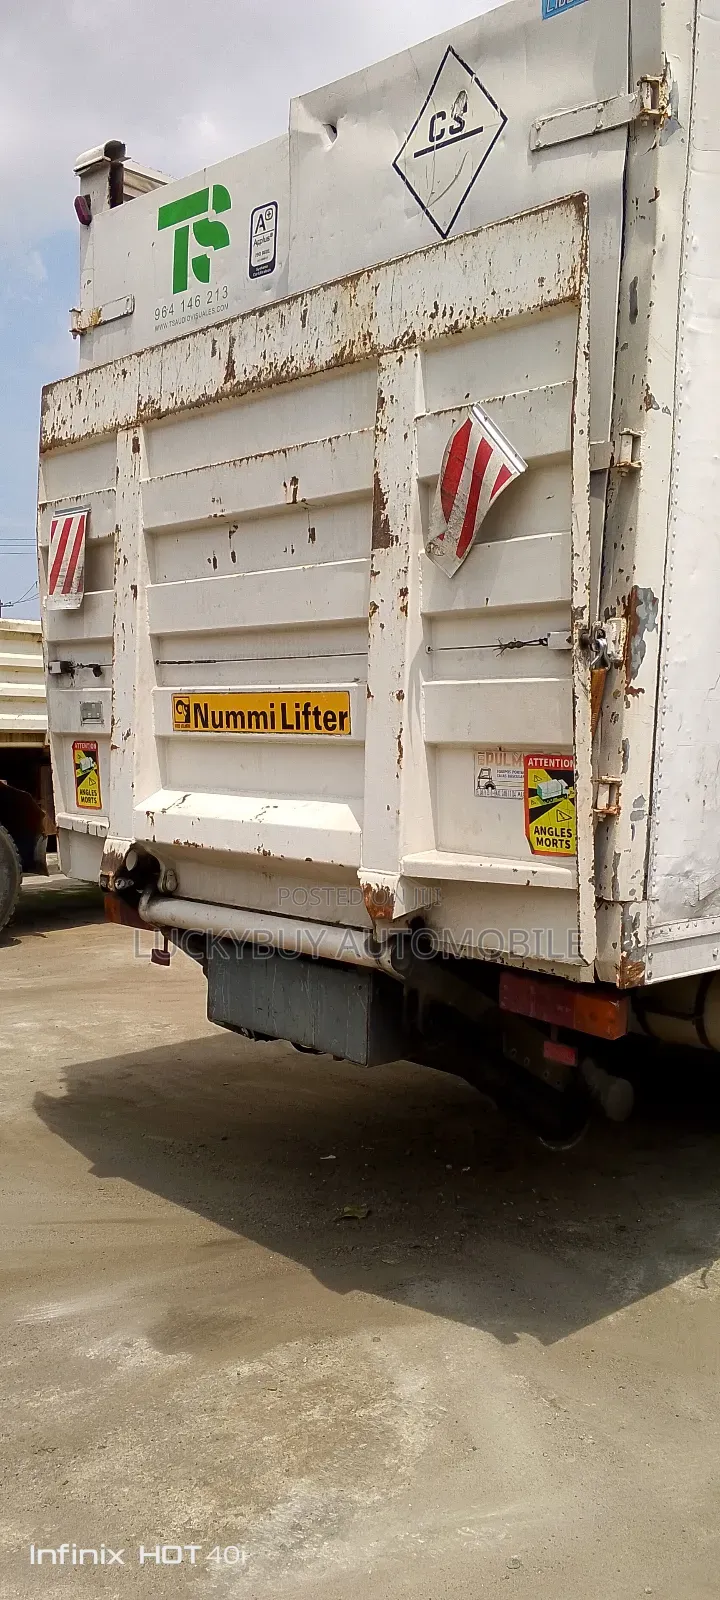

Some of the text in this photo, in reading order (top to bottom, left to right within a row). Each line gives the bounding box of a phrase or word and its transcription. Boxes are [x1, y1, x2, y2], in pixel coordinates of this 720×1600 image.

[428, 99, 468, 142] CS
[158, 184, 232, 295] TS
[154, 286, 228, 320] 964 146 213
[193, 701, 348, 731] Nummi Lifter
[80, 788, 97, 797] ANGLES
[80, 796, 97, 804] MORTS
[534, 826, 573, 838] ANGLES
[536, 837, 571, 849] MORTS
